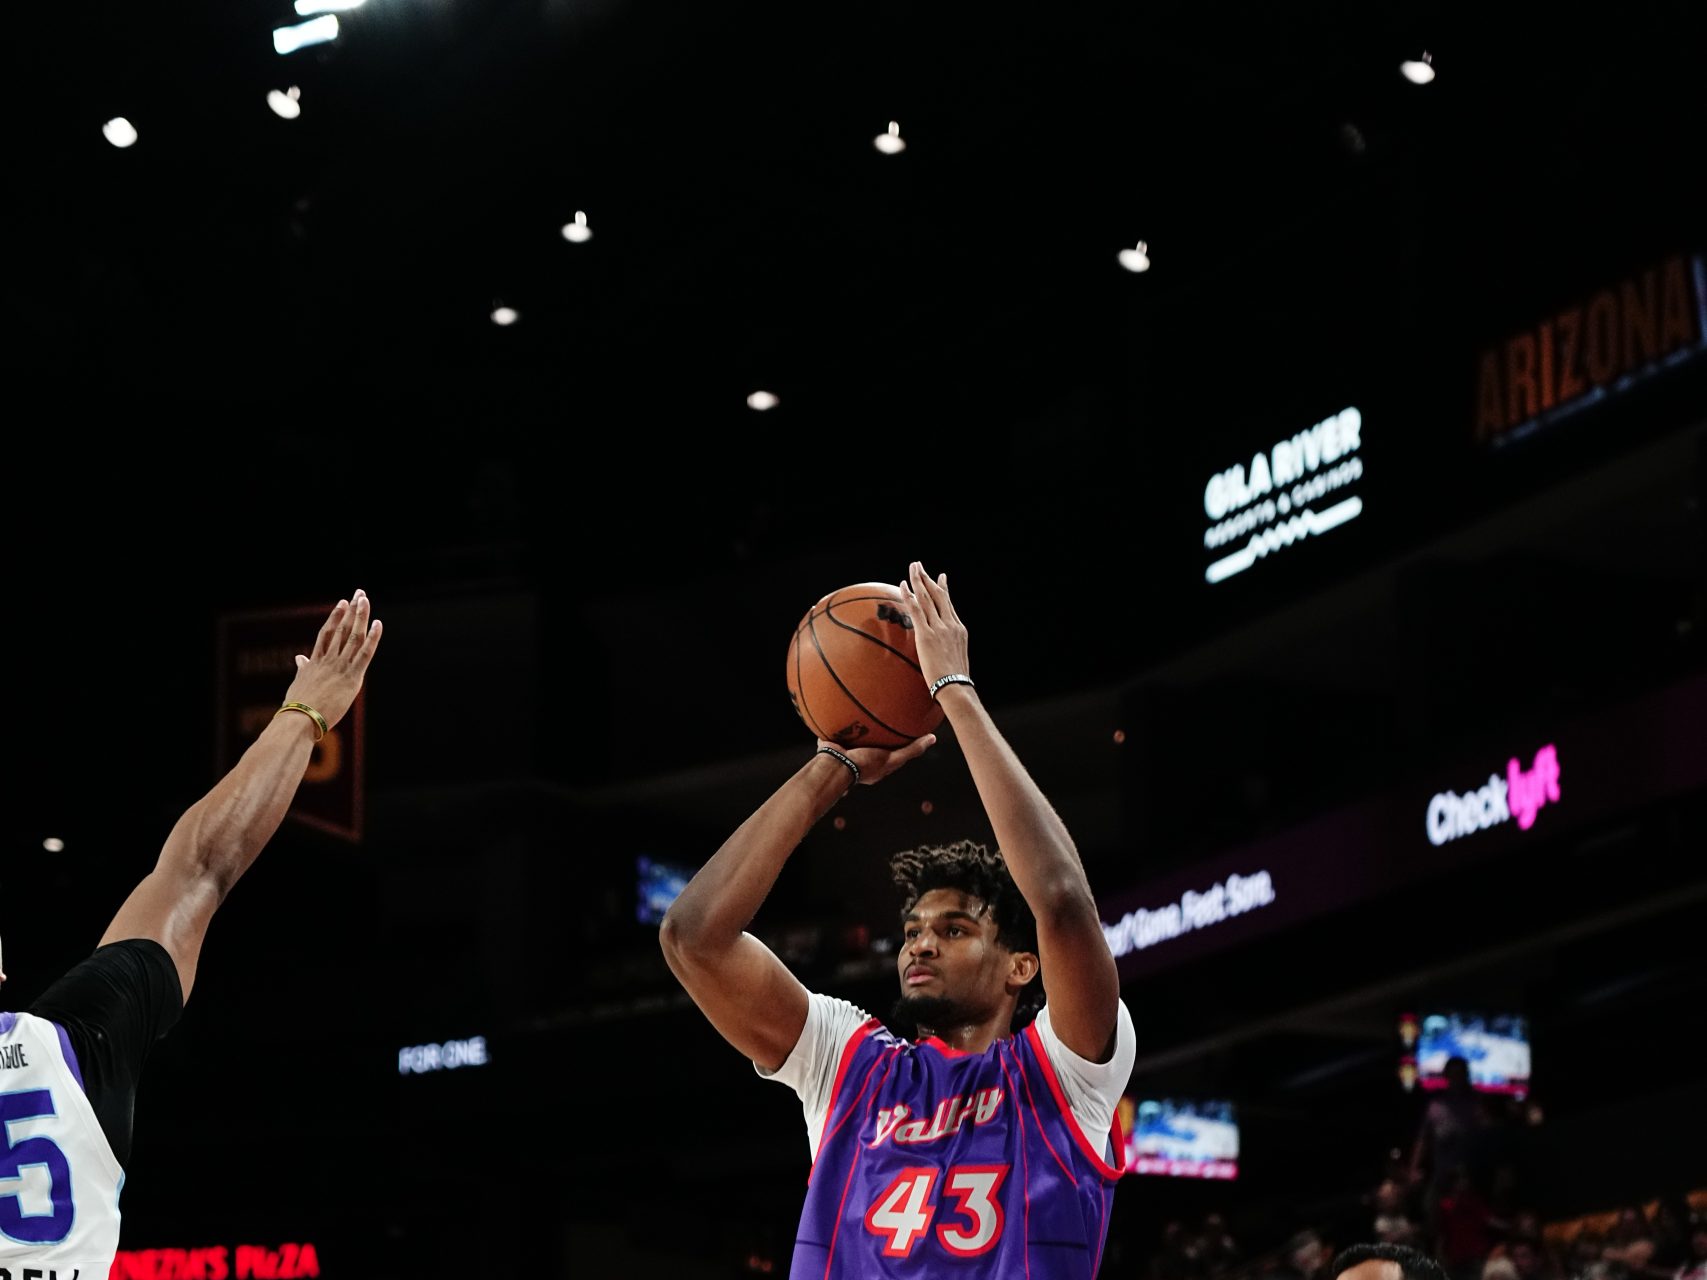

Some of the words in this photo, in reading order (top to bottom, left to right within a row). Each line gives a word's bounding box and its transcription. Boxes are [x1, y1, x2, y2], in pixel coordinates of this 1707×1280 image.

[1473, 254, 1692, 444] ARIZONA
[1204, 452, 1272, 520] GILA
[1271, 406, 1362, 488] RIVER
[399, 1046, 442, 1074] FOR
[0, 1086, 76, 1246] 5
[864, 1164, 1010, 1259] 43
